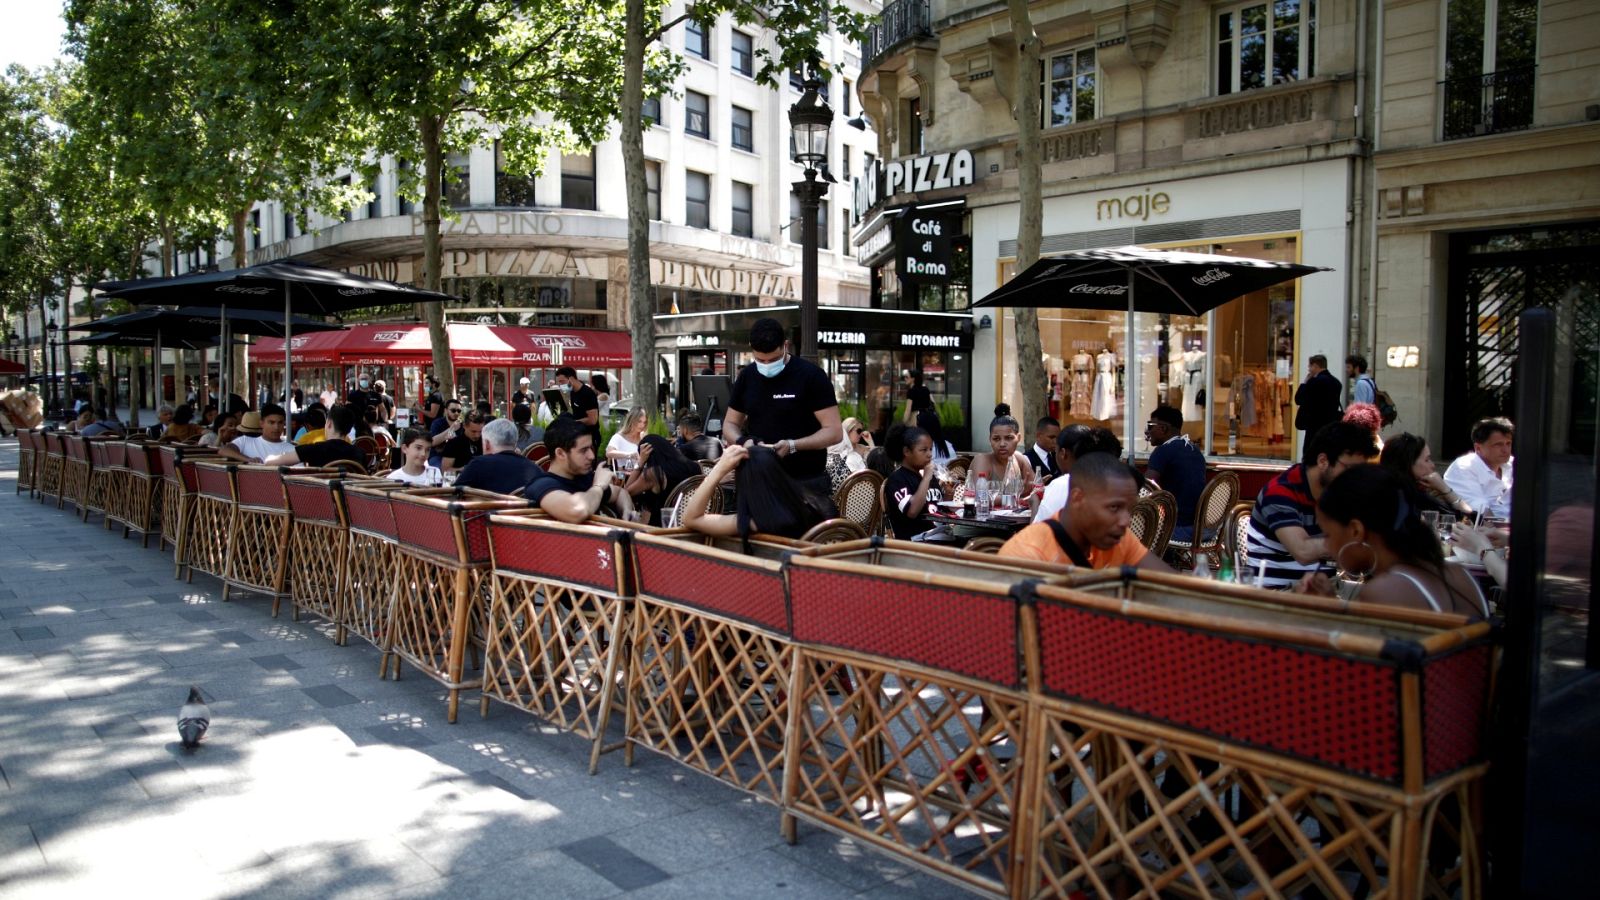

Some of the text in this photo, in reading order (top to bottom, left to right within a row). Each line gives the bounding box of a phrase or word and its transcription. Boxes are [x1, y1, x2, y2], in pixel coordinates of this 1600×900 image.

[886, 149, 973, 197] PIZZA
[1096, 188, 1171, 221] maje
[411, 213, 563, 236] PZA PINO
[912, 218, 942, 236] Café
[922, 241, 932, 253] di
[444, 248, 592, 277] PIZZA
[907, 257, 946, 275] Roma
[660, 259, 799, 298] PINO PIZZA
[817, 331, 960, 347] PIZZERIA RISTORANTE
[522, 352, 541, 361] PIZZA
[542, 352, 552, 361] PIN
